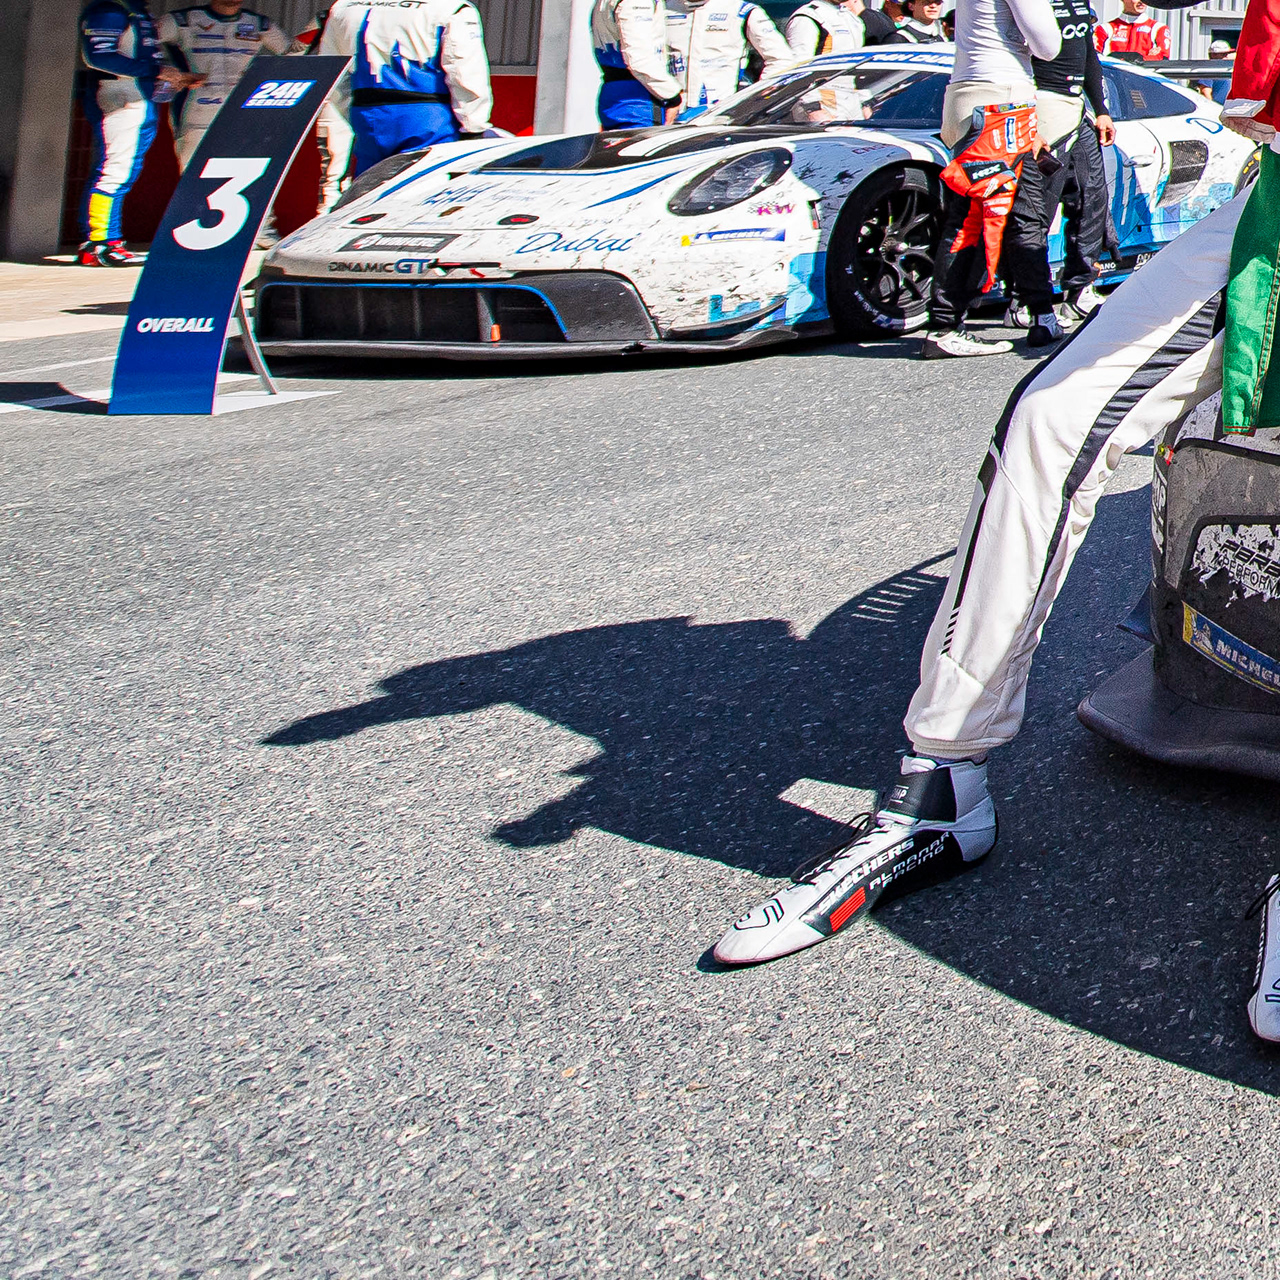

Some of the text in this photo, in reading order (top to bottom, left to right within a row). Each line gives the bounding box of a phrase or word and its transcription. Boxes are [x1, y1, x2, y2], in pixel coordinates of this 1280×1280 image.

[254, 82, 311, 99] 24H
[245, 98, 298, 107] SERIES
[172, 158, 271, 250] 3
[515, 230, 641, 254] Dubai
[329, 259, 432, 273] DINAMIC GT
[137, 317, 215, 333] OVERALL
[819, 837, 915, 915] SKECHERS
